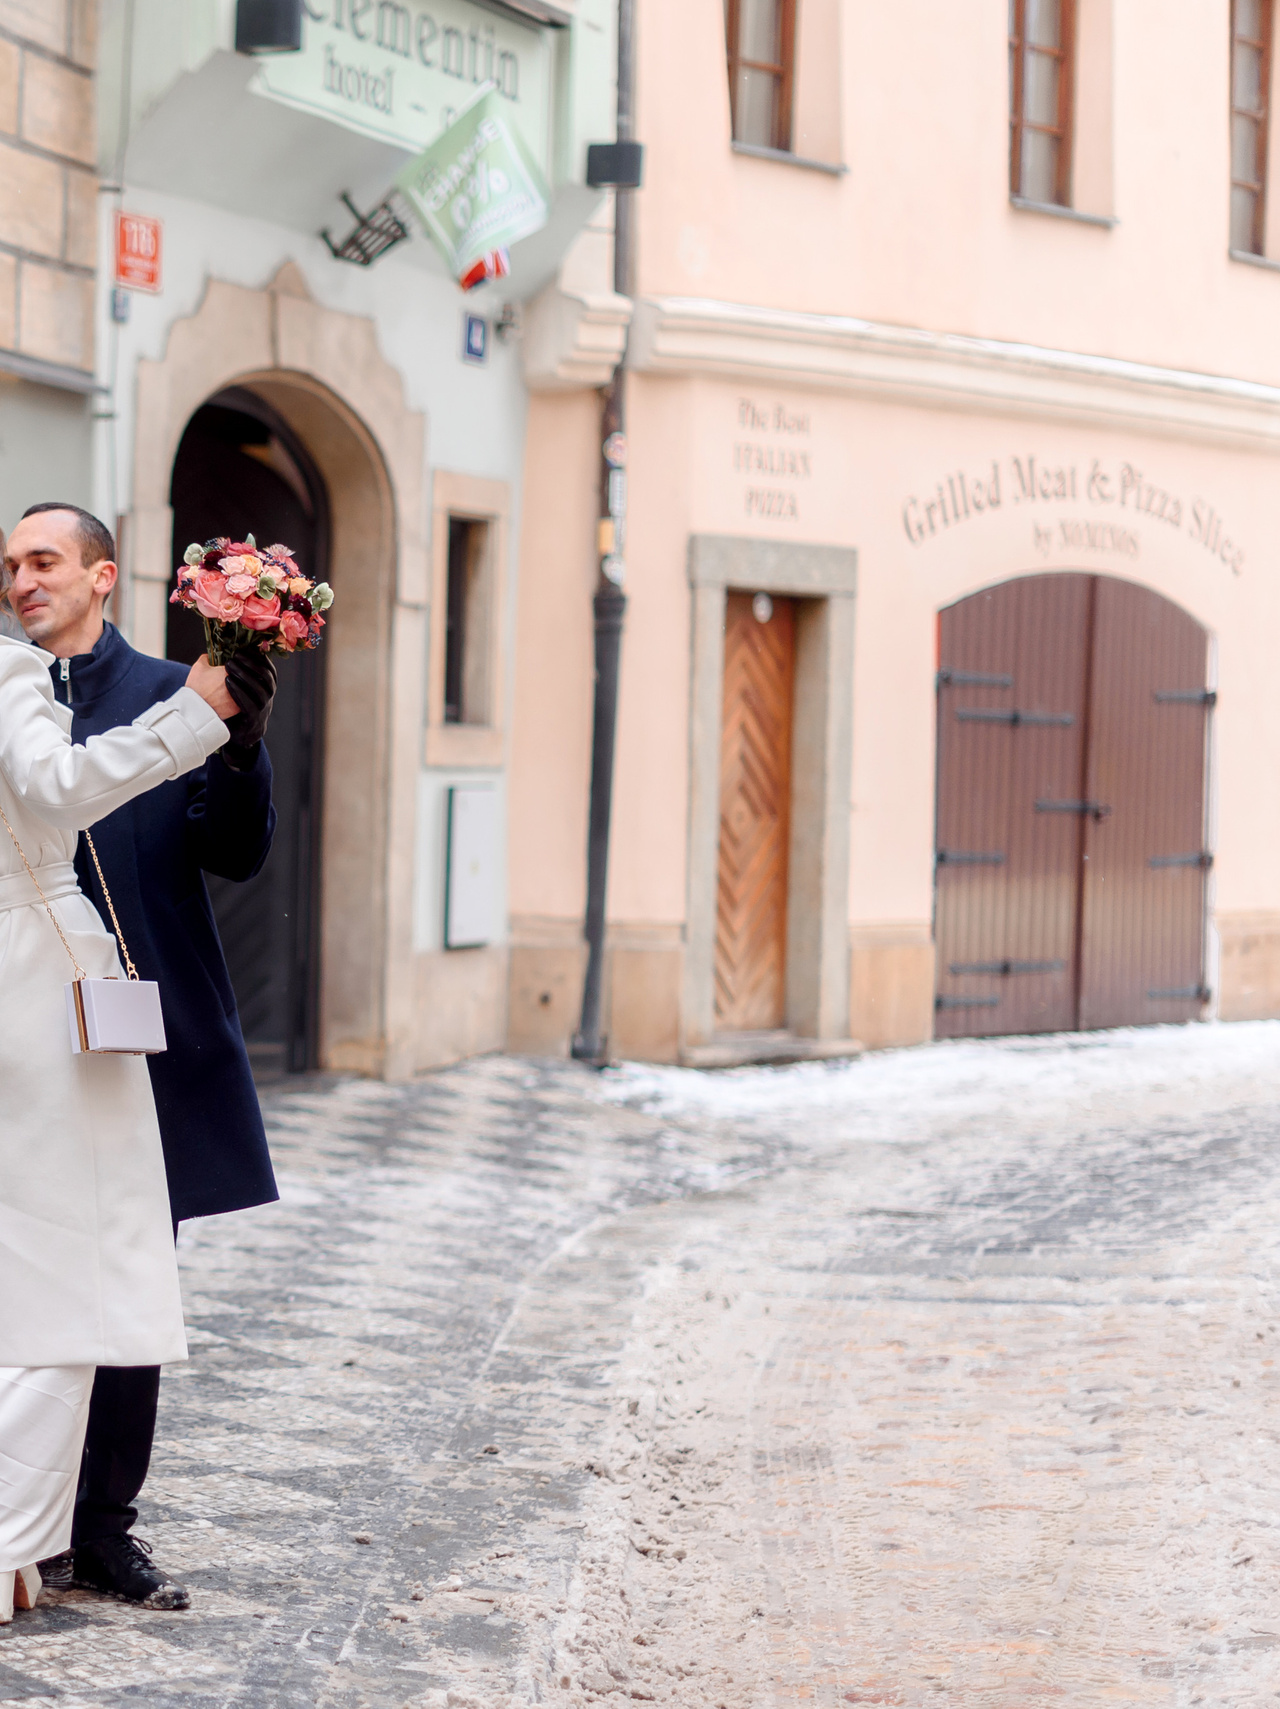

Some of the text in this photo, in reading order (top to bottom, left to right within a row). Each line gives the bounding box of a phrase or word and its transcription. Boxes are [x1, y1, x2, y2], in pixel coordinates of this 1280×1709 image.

[324, 42, 393, 115] hotel
[738, 398, 768, 432] The
[732, 441, 812, 479] ITALIAN
[744, 486, 800, 522] PIZZA
[902, 454, 1246, 577] Grilled Meat & Pizza Slice
[1032, 519, 1054, 559] by
